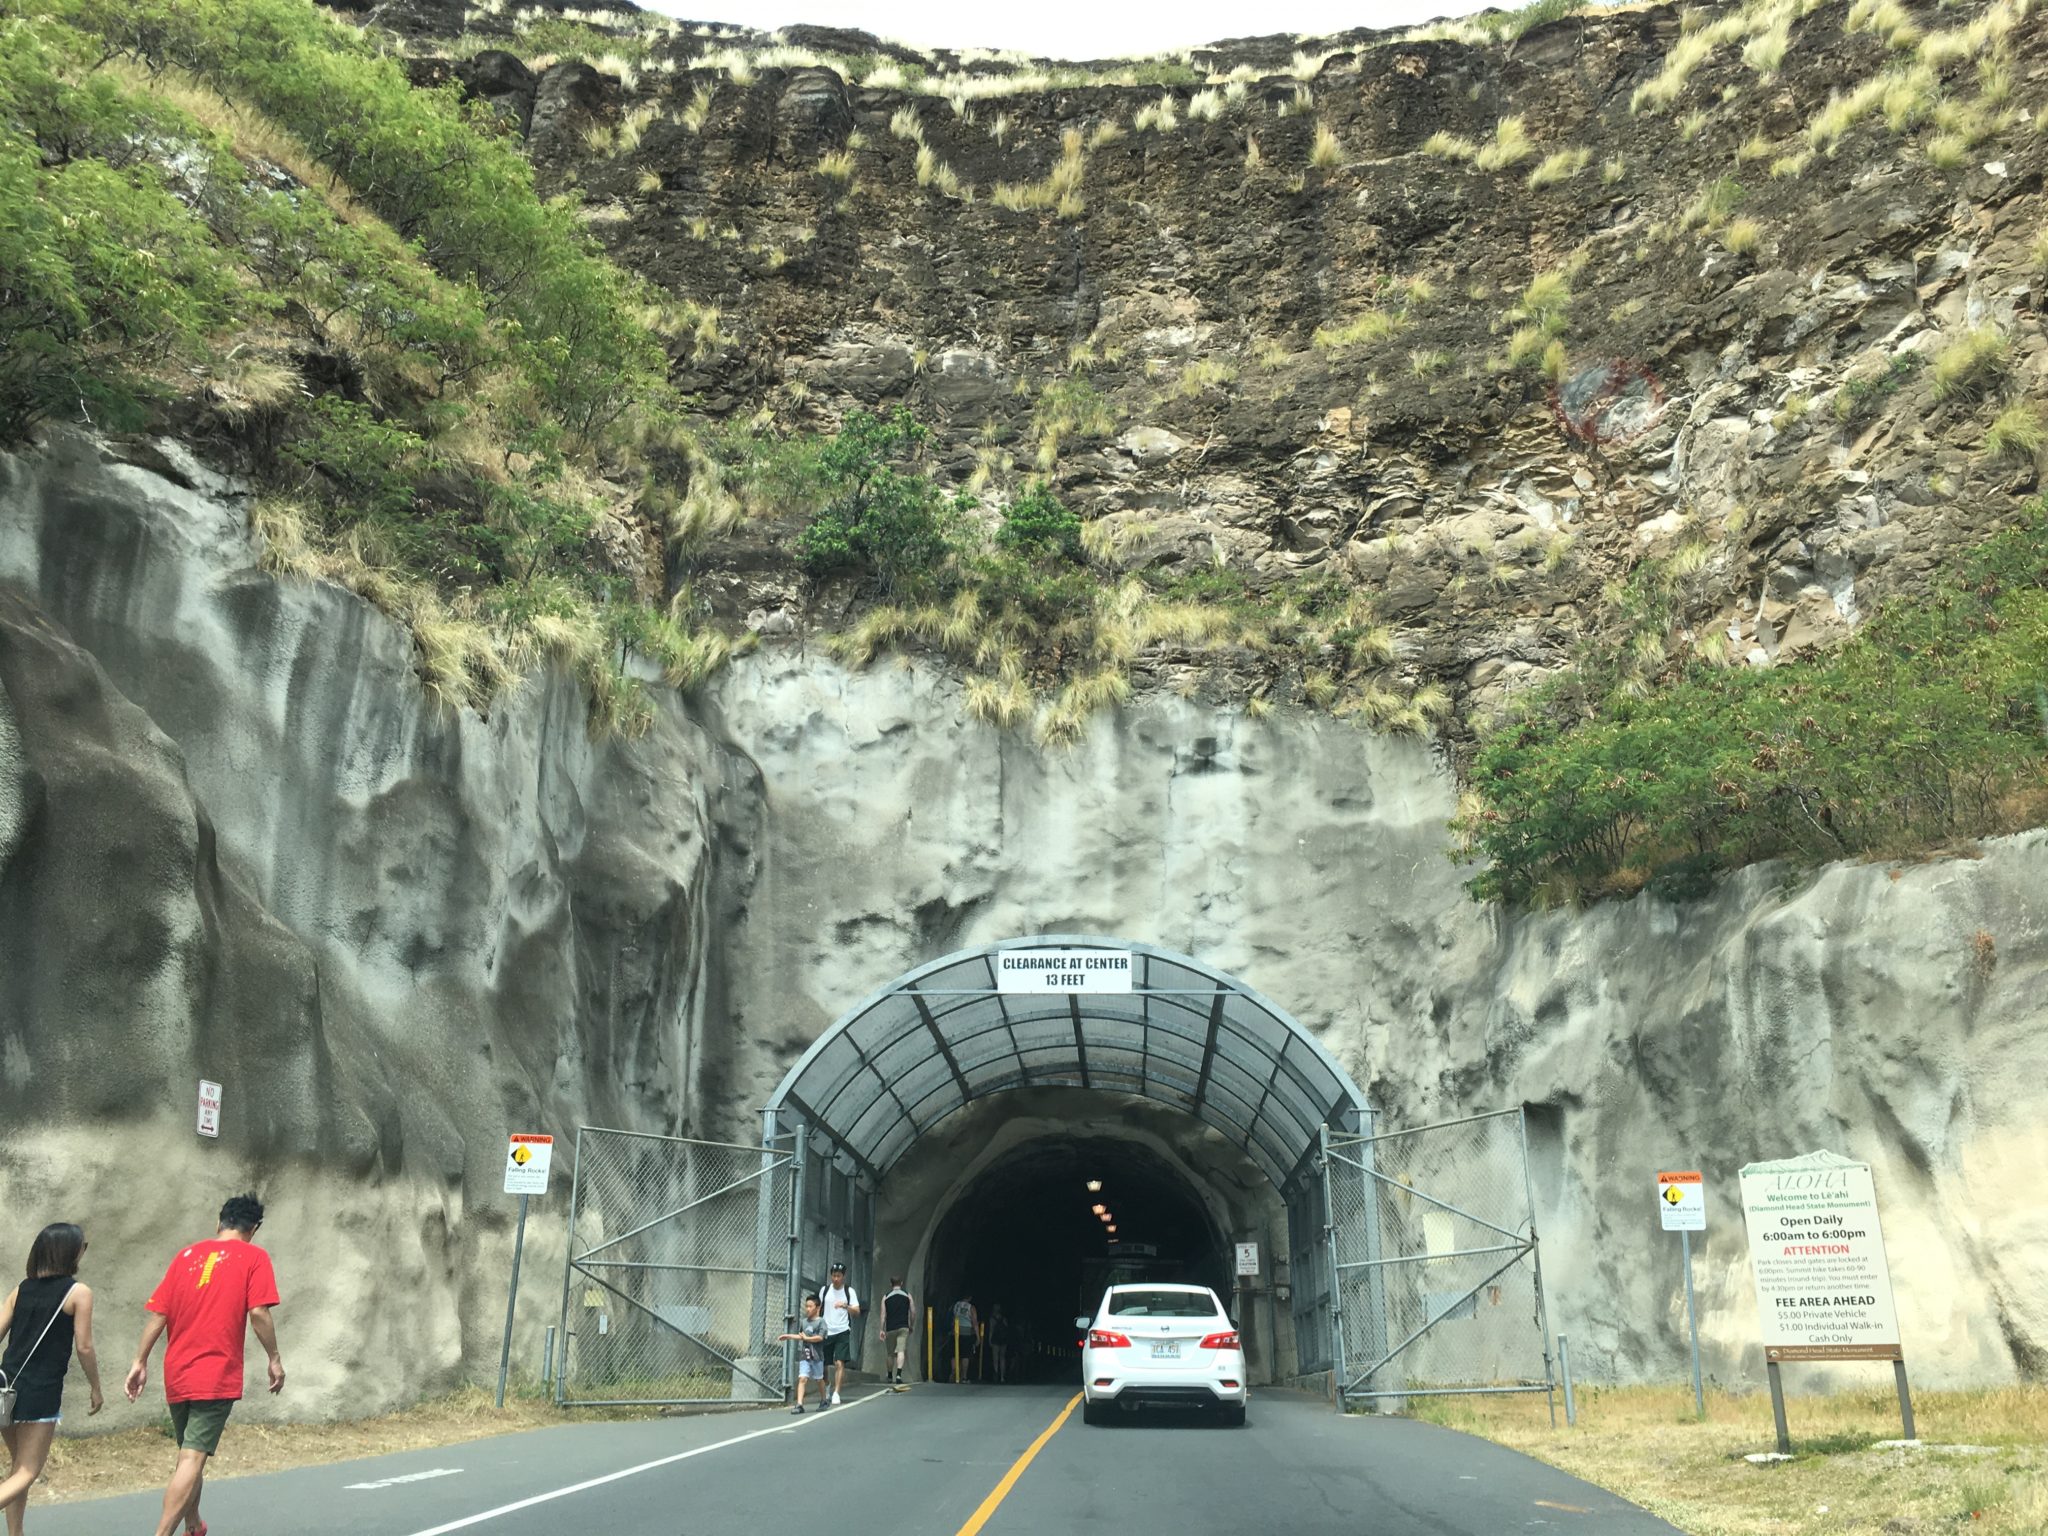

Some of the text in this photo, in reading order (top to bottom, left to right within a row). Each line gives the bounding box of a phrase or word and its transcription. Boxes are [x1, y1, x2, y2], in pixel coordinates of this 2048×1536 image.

[1003, 957, 1128, 969] CLEARANCE AT CENTER
[1045, 974, 1085, 986] 13 FEET
[206, 1087, 215, 1098] NO
[200, 1097, 219, 1110] PARKING
[1764, 1172, 1846, 1192] ALOHA
[1766, 1193, 1808, 1202] Welcome
[1749, 1203, 1785, 1212] (Diamond
[1786, 1202, 1805, 1210] Head
[1827, 1200, 1871, 1209] Monument)
[1780, 1214, 1843, 1228] Open Daily
[1763, 1229, 1866, 1241] 6:00am to 6:00pm
[1244, 1248, 1250, 1258] 5
[1783, 1244, 1850, 1256] ATTENTION
[1807, 1258, 1825, 1266] gates
[1761, 1285, 1770, 1293] by
[1775, 1295, 1875, 1307] FEE AREA AHEAD
[1778, 1309, 1866, 1320] $5.00 Private Vehicle
[1780, 1321, 1883, 1332] $1.00 Individual Walk-in
[1809, 1334, 1853, 1344] Cash Only
